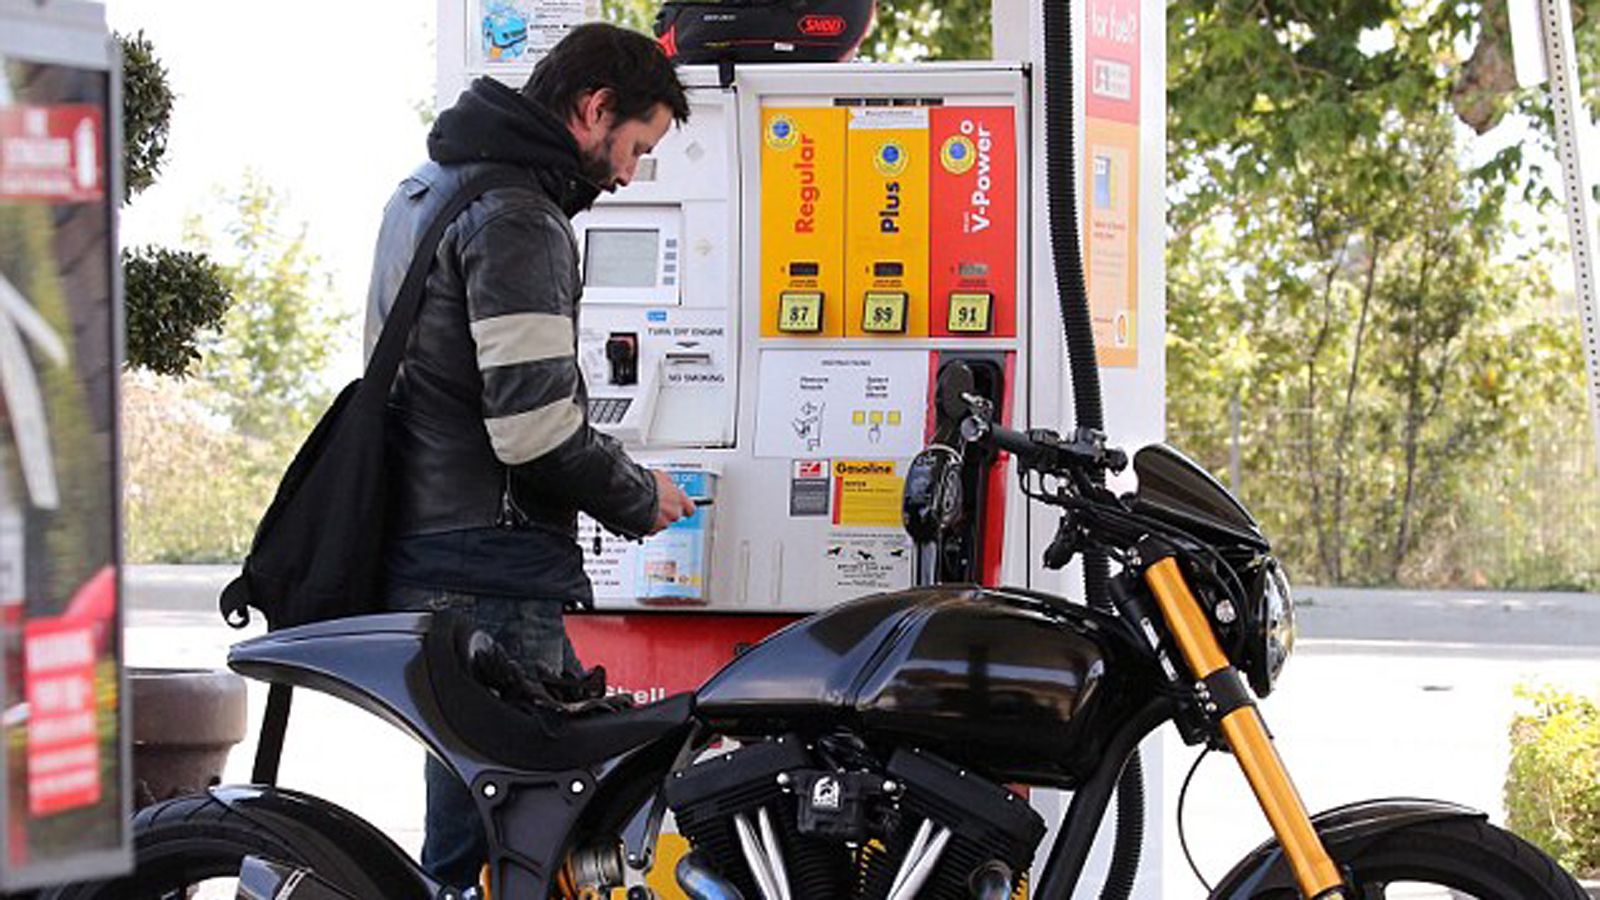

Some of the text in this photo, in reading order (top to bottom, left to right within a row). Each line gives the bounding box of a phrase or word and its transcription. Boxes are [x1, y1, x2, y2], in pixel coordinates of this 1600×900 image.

[794, 133, 821, 233] Regular
[970, 126, 993, 233] V-Power
[878, 180, 901, 233] Plus
[789, 306, 809, 322] 87
[873, 306, 893, 323] 89
[957, 306, 977, 322] 91
[648, 327, 671, 336] TURN
[691, 327, 724, 336] ENGINE
[668, 374, 725, 382] NO SMOKING
[836, 461, 891, 474] Gasoline
